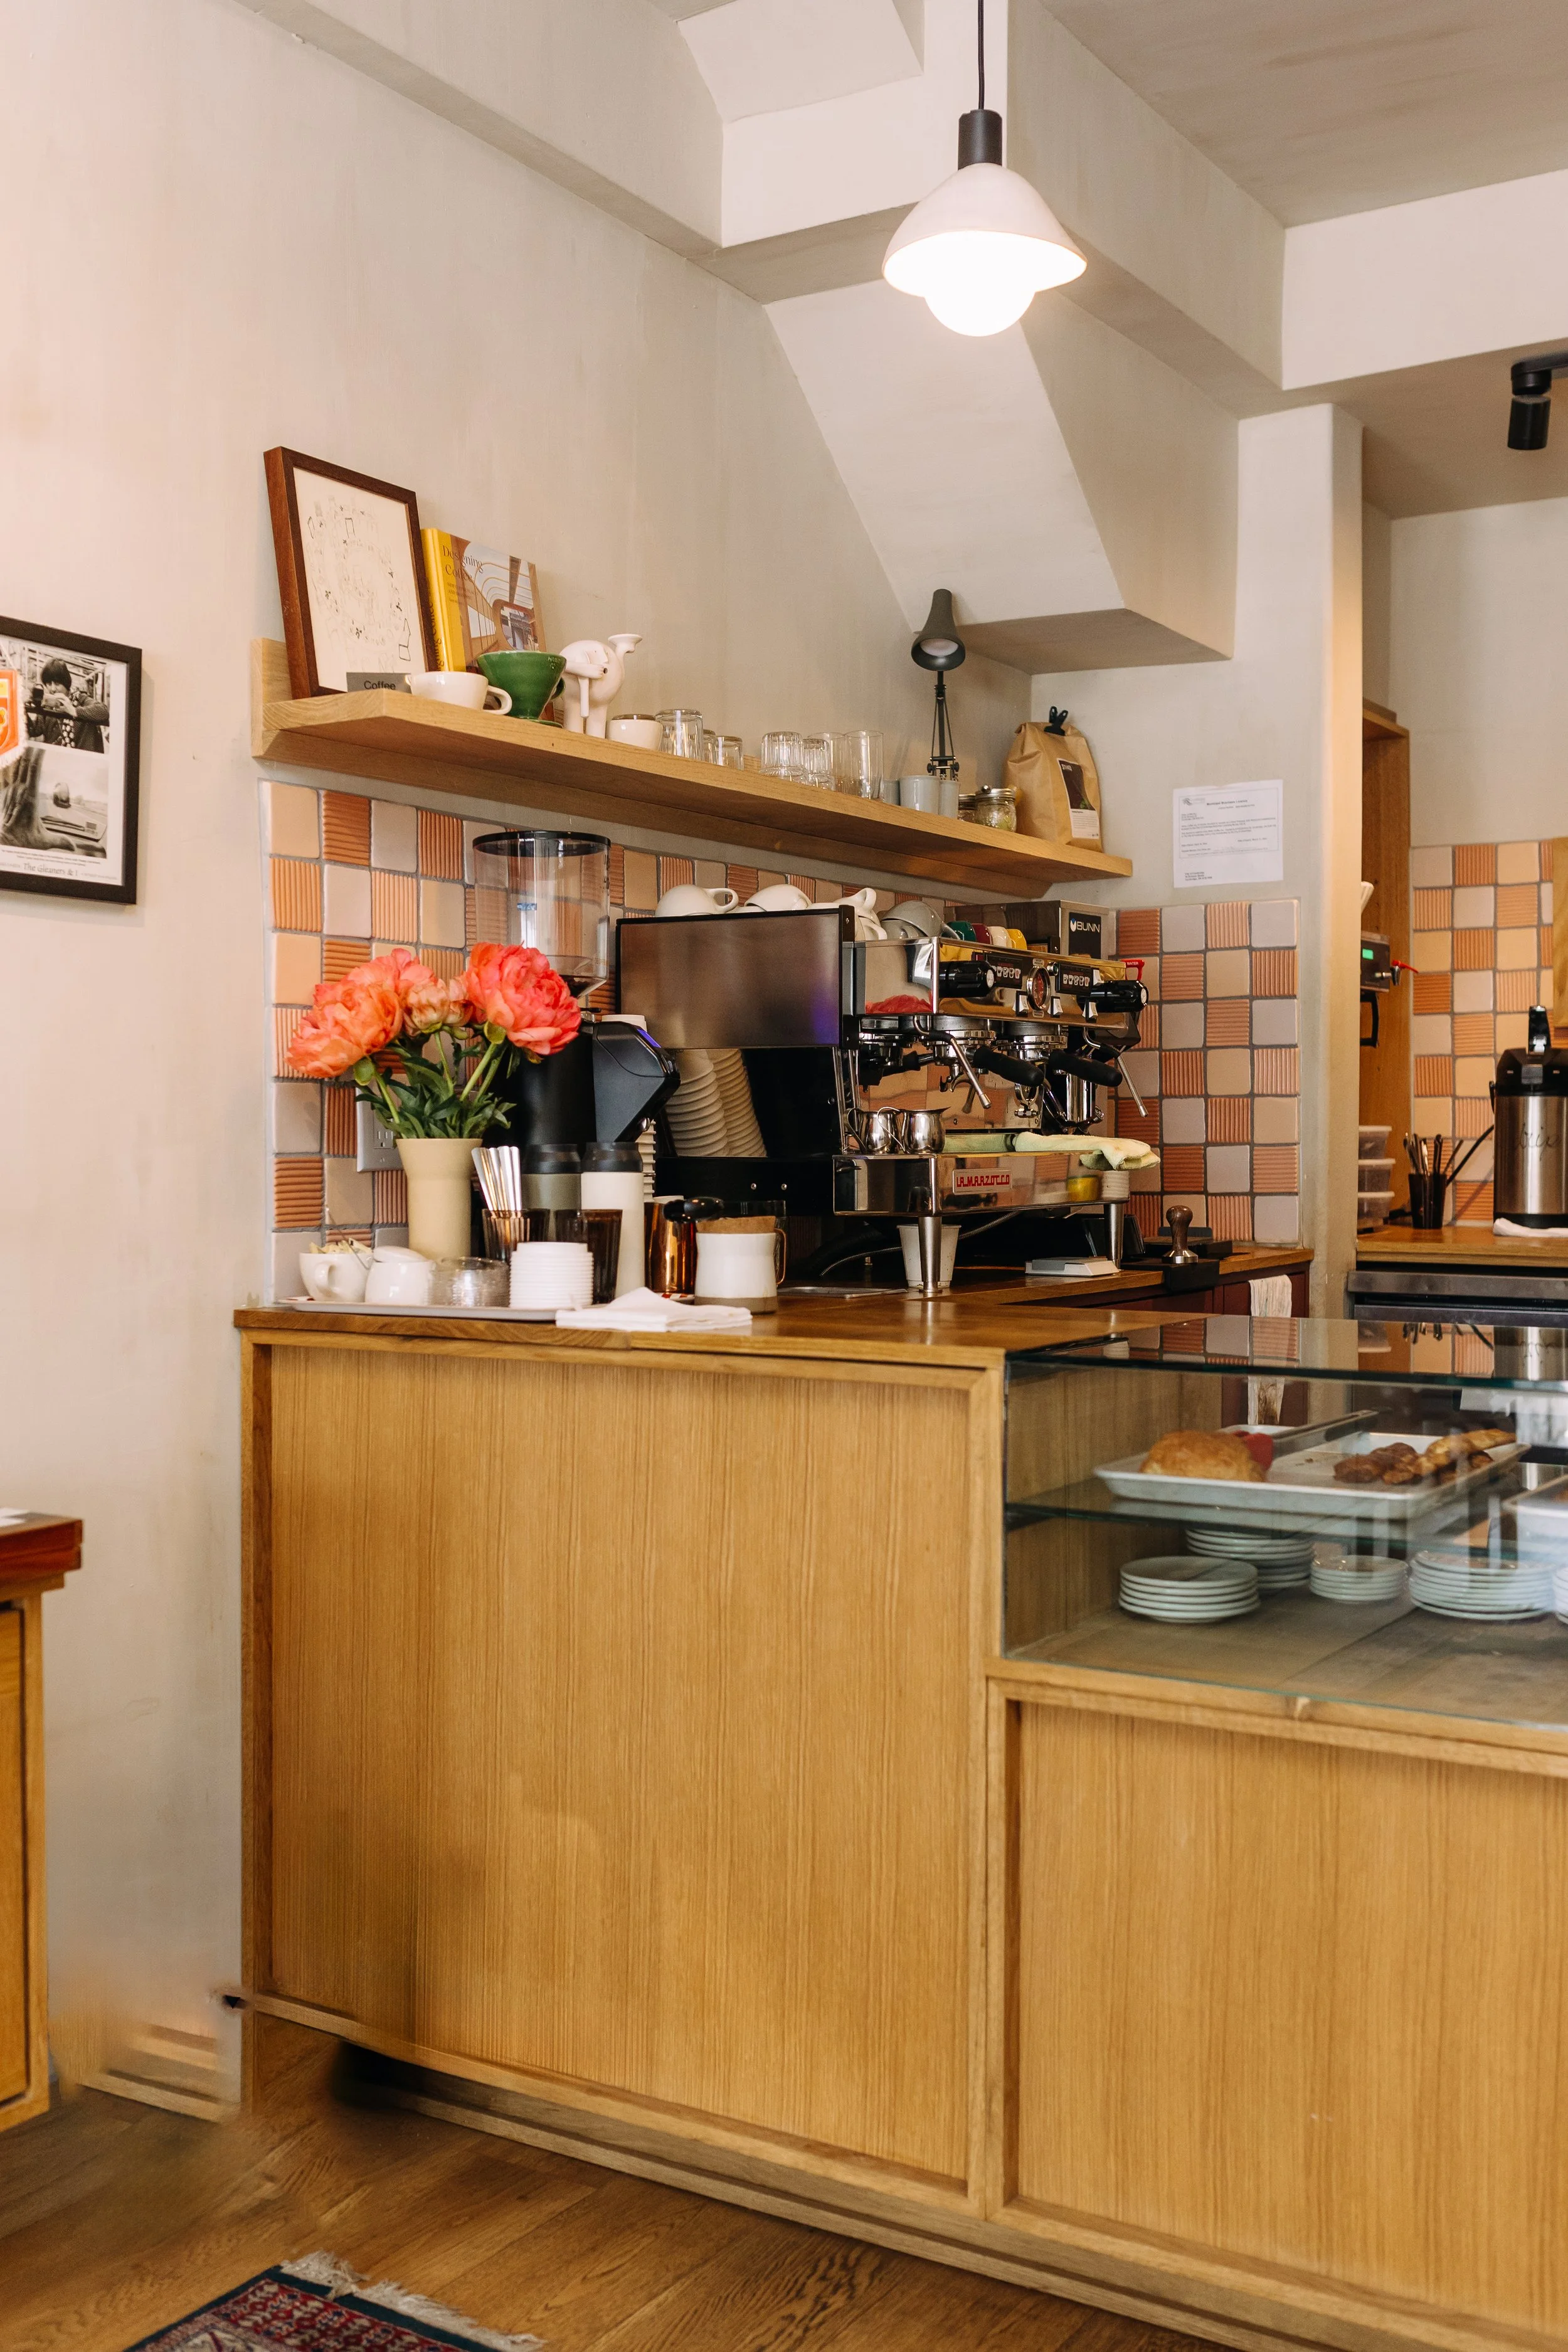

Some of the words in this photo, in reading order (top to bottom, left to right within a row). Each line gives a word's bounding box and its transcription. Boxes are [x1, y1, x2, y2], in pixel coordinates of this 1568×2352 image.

[442, 544, 484, 574] Designing
[445, 564, 473, 583] Coffee
[364, 680, 396, 691] Coffee
[24, 862, 36, 872] The
[37, 864, 65, 876] Gleaners
[1076, 921, 1100, 933] BUNN
